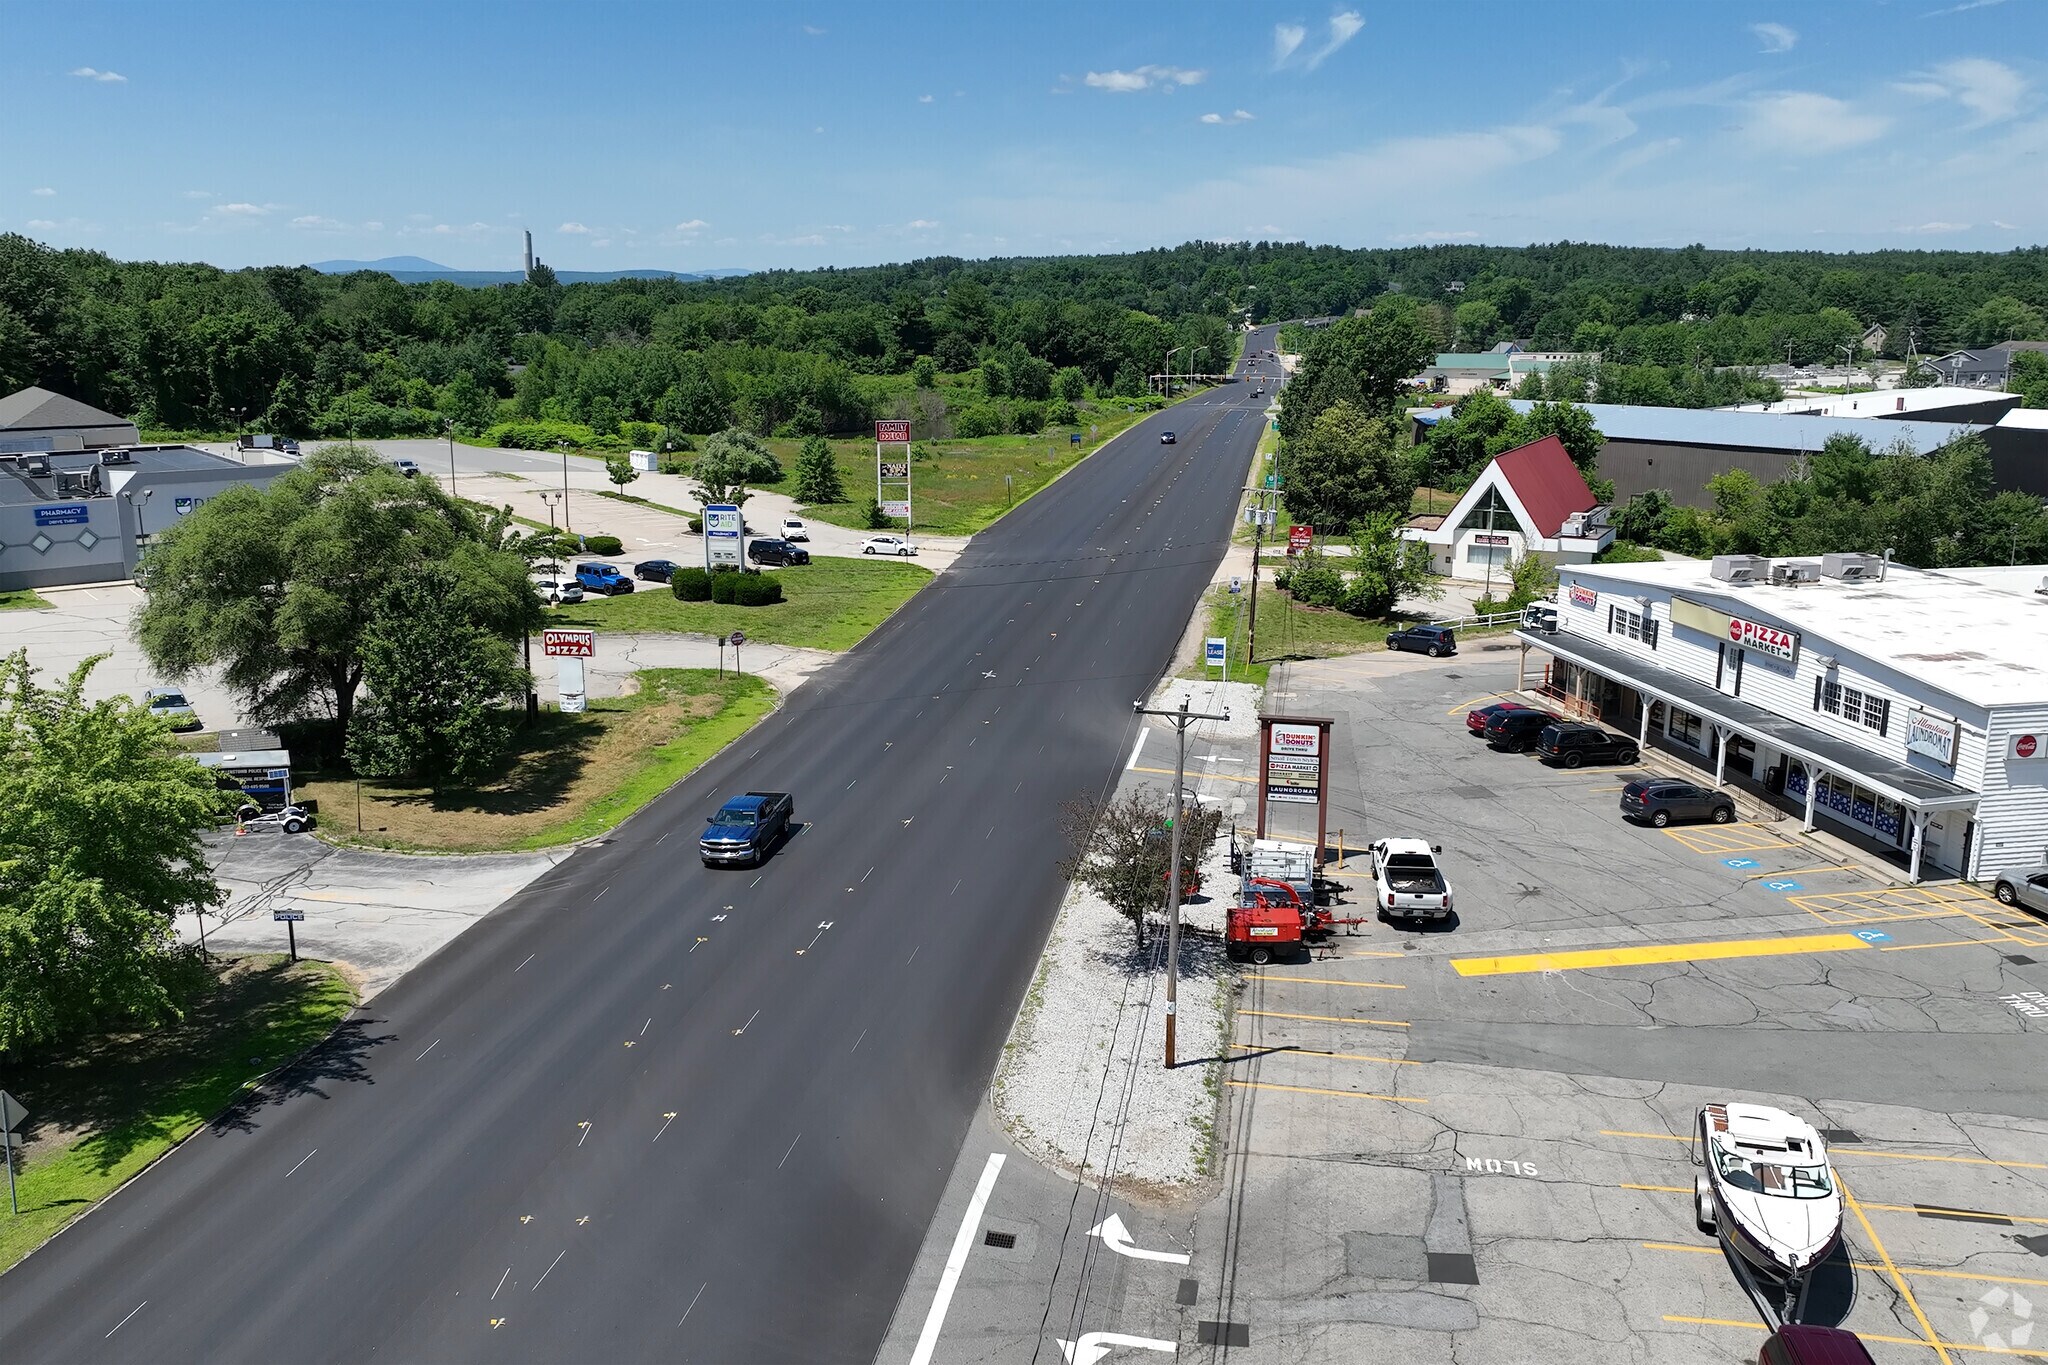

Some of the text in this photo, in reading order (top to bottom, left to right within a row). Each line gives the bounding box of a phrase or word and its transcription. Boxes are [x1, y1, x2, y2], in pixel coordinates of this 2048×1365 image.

[879, 423, 907, 431] FAMILY
[40, 508, 82, 517] PHARMACY
[1575, 593, 1595, 606] DONUTS
[545, 633, 591, 647] OLYMPUS
[1744, 622, 1790, 649] PIZZA
[547, 646, 591, 655] PIZZA
[1744, 637, 1782, 656] MARKET
[1912, 717, 1950, 737] Allenstown
[1906, 724, 1951, 759] LAUNDROMAT
[1270, 786, 1317, 794] LAUNDROMAT
[1999, 994, 2048, 1017] THRU
[1465, 1157, 1538, 1176] SLOW
